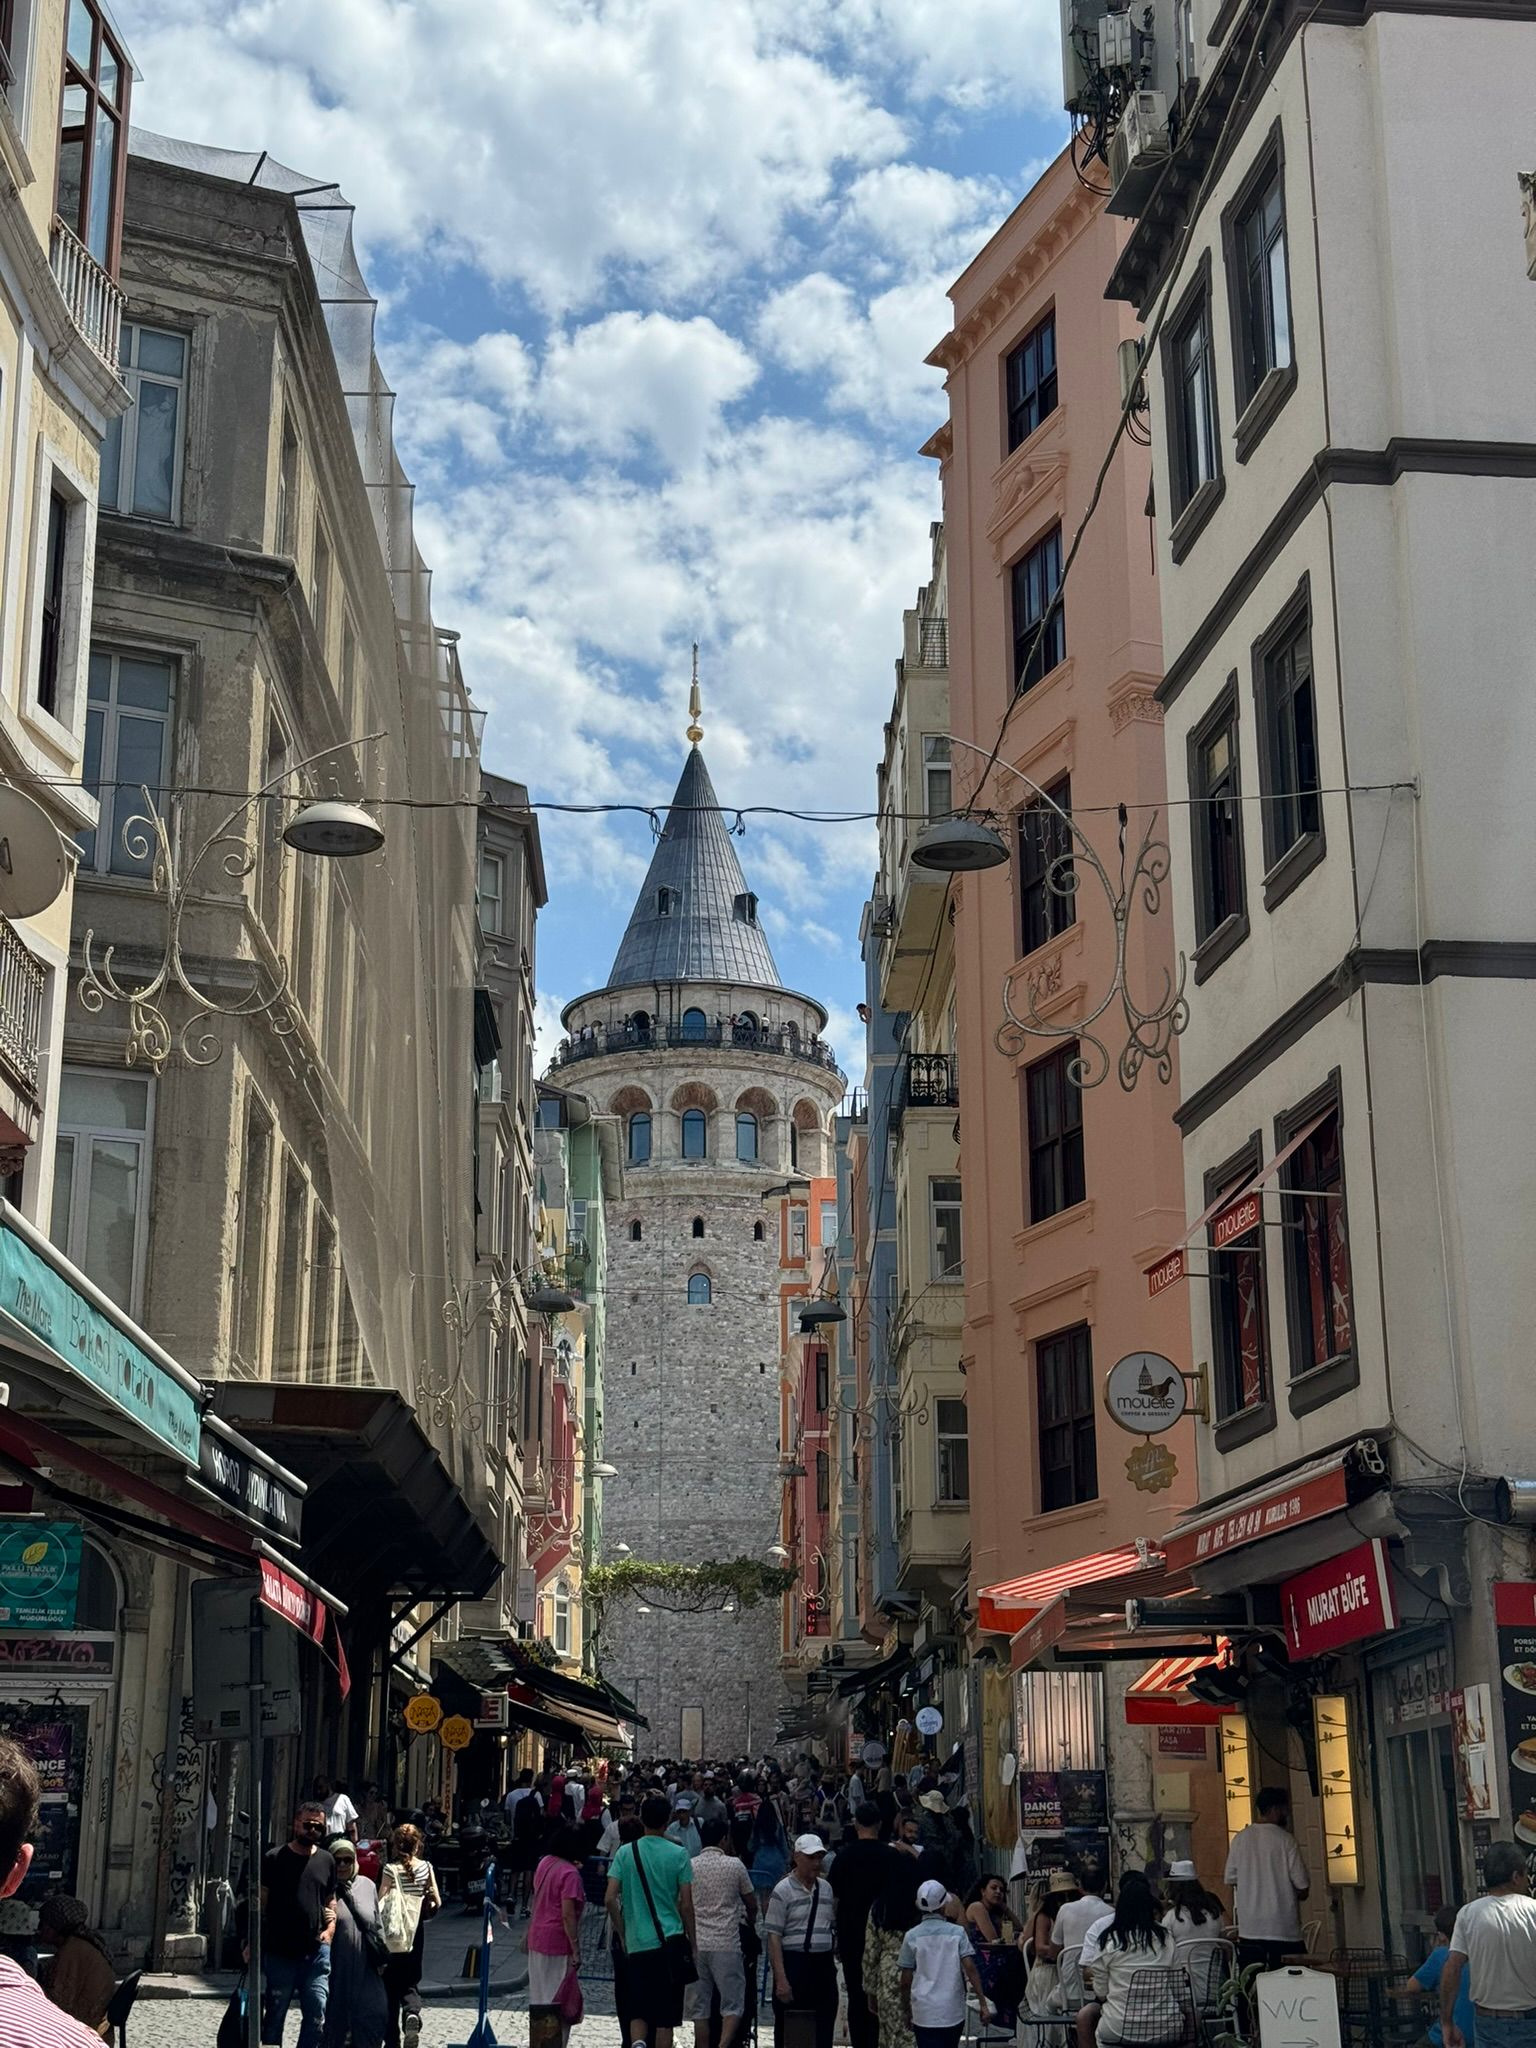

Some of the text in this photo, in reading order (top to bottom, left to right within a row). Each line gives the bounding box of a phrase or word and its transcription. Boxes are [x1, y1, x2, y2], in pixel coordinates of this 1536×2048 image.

[1216, 1201, 1256, 1242] mouette
[1150, 1256, 1181, 1292] mouette
[1116, 1395, 1176, 1410] mouette
[1306, 1571, 1370, 1627] MURAT BÜFE
[1024, 1801, 1062, 1811] DANCE
[1262, 1995, 1319, 2022] WC
